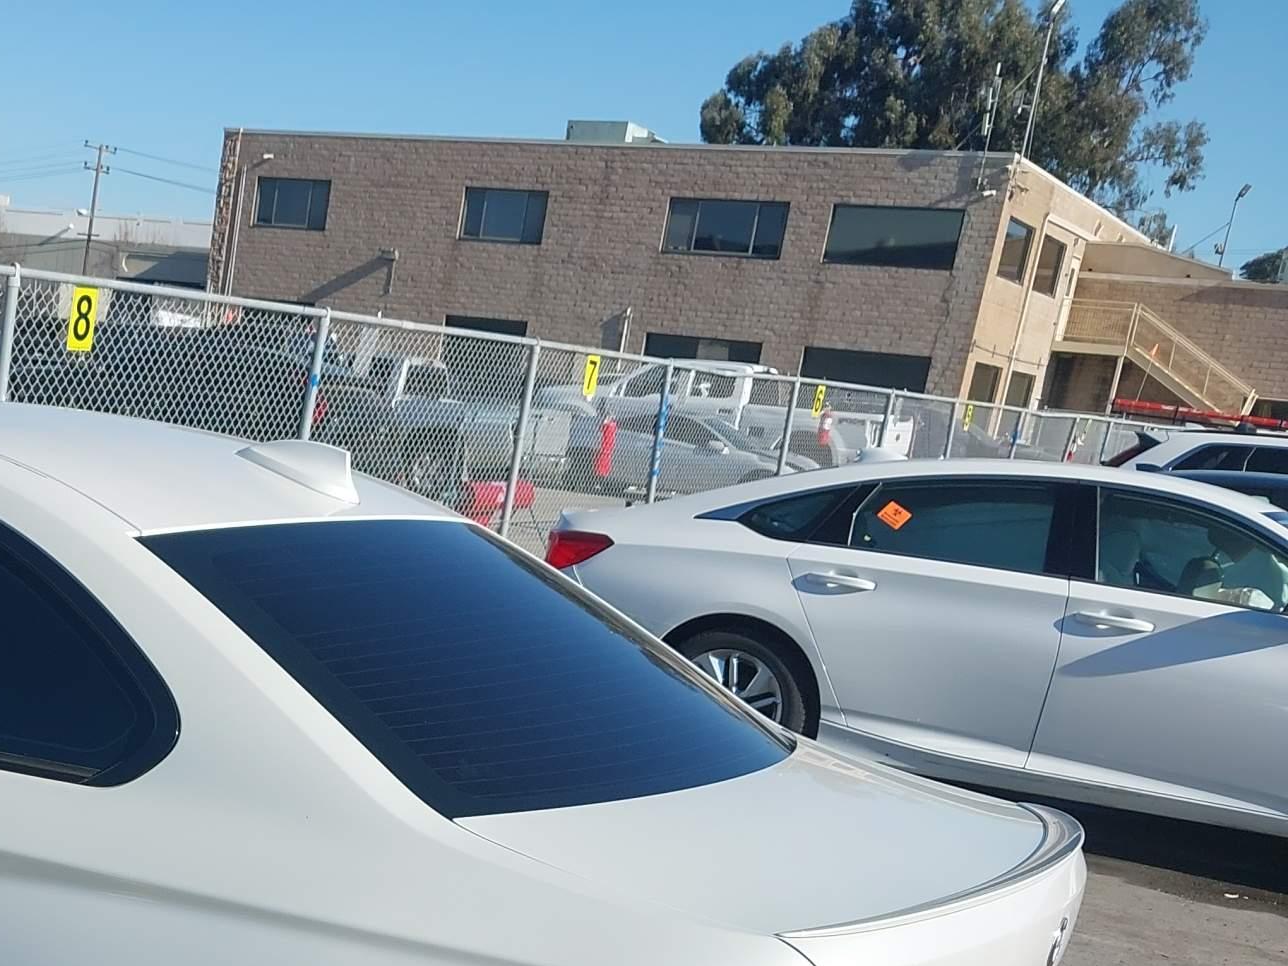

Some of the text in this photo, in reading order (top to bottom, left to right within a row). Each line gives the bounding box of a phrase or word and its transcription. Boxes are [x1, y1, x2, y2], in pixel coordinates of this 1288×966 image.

[73, 294, 92, 341] 8
[587, 360, 597, 389] 7
[815, 390, 823, 411] 6
